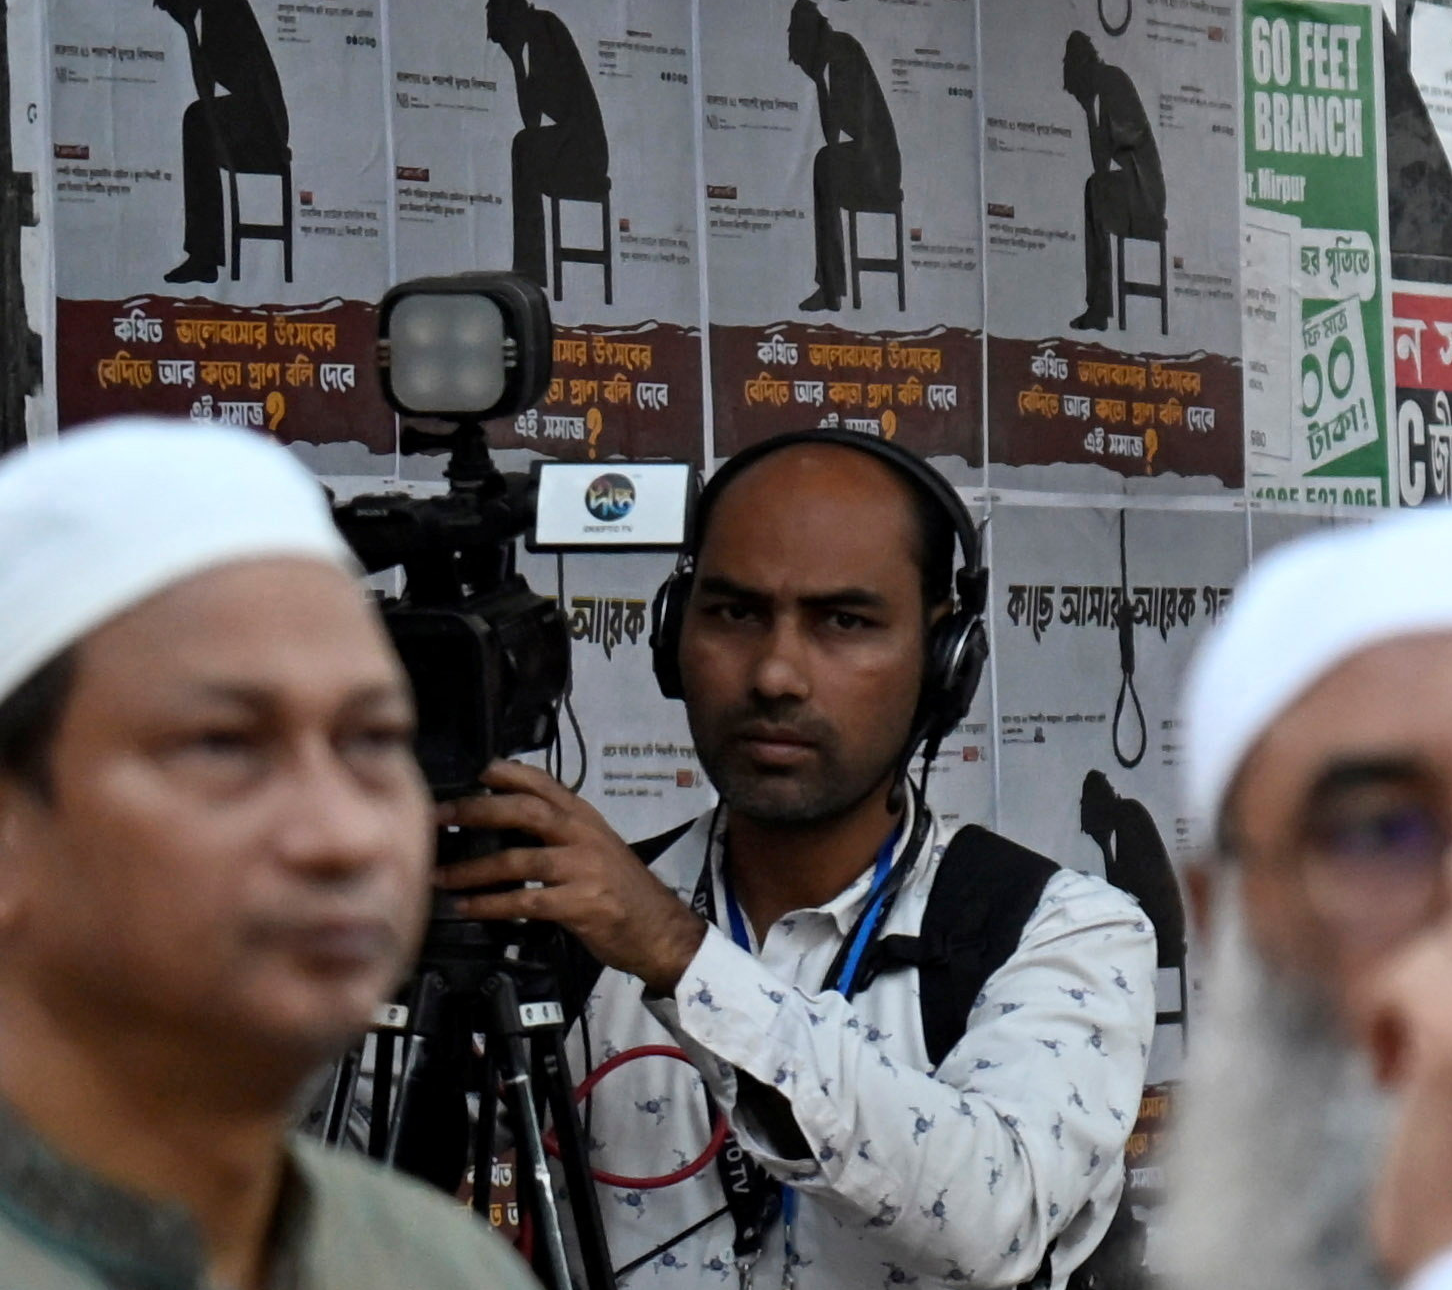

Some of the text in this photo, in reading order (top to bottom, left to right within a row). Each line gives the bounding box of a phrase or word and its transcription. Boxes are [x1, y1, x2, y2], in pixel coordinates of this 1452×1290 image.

[1251, 15, 1292, 87] 60
[1299, 20, 1361, 91] FEET
[1254, 91, 1364, 158] BRANCH
[1258, 166, 1306, 205] Mirpur
[113, 309, 336, 352] কথিত ভালোবাসার উৎসবের
[98, 350, 355, 393] বেদিতে আর কতো প্রাণ বলি দেবে
[553, 336, 652, 370] াসার উৎসবের
[757, 334, 942, 373] কথিত ভালোবাসার উৎসবের
[1031, 349, 1068, 380] কথিত
[1077, 360, 1147, 391] ভালোবাসার
[570, 372, 669, 411] প্রাণ বলি দেবে
[745, 371, 790, 407] বেদিতে
[793, 380, 824, 408] আর
[828, 382, 861, 408] কতো
[898, 375, 923, 407] বলি
[927, 384, 957, 411] দেবে
[1018, 384, 1059, 419] বেদিতে
[1063, 394, 1091, 421] আর
[1094, 397, 1126, 424] কতো
[1159, 396, 1183, 426] বলি
[1187, 406, 1215, 433] দেবে
[514, 408, 538, 439] এই
[1084, 427, 1104, 455] এই
[571, 595, 647, 662] আরেক
[1007, 584, 1197, 645] কাছে আসার আরেক
